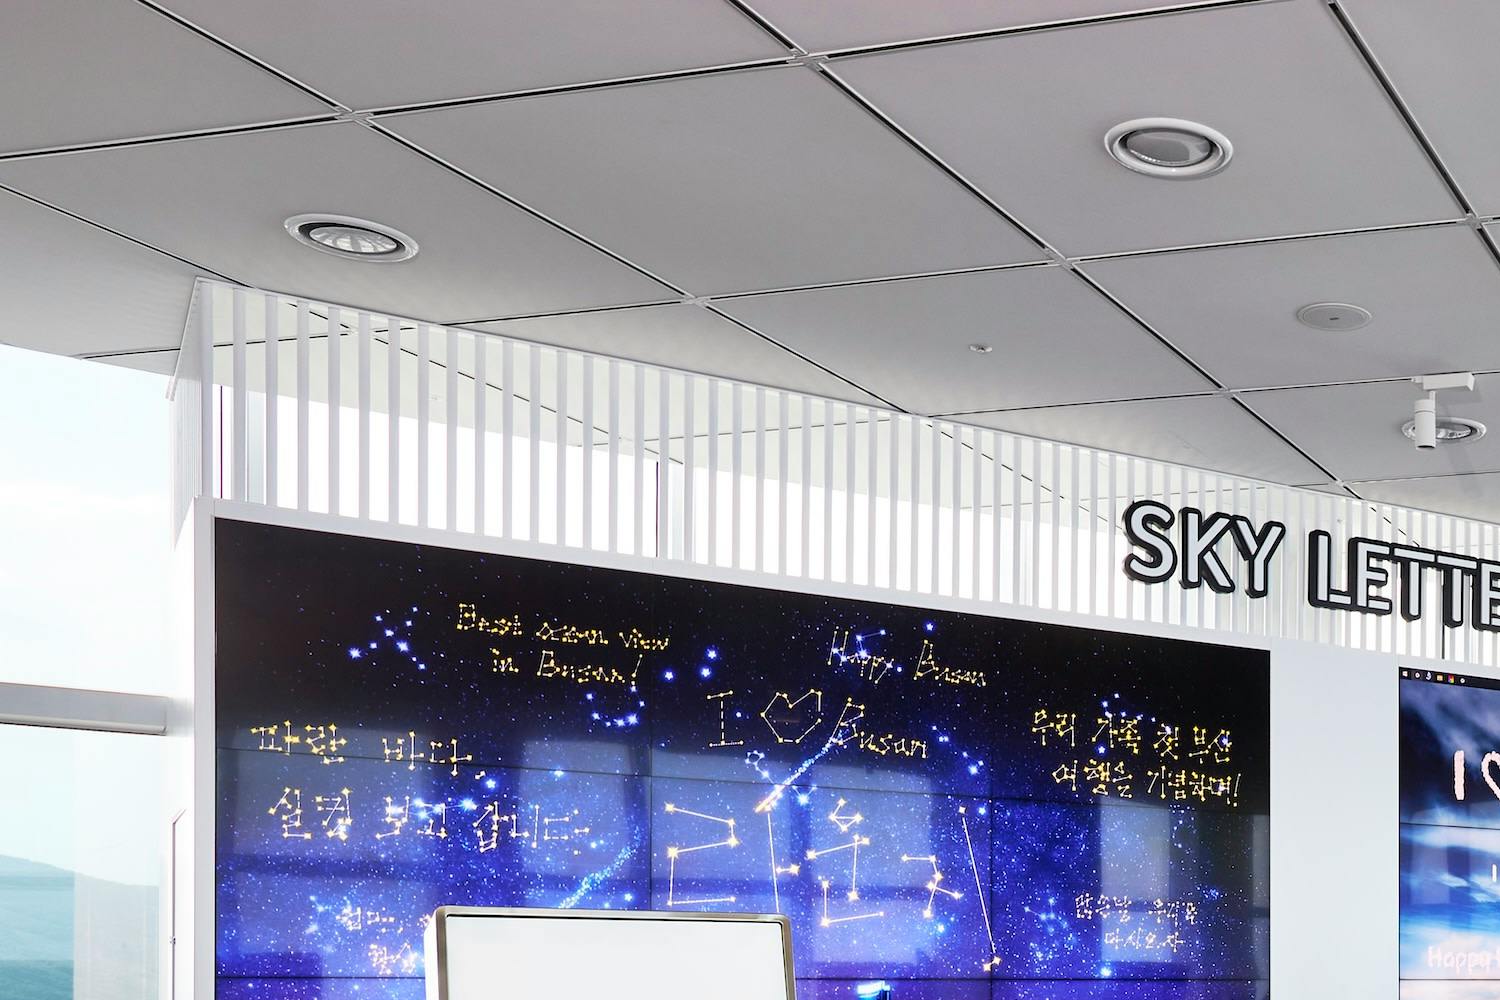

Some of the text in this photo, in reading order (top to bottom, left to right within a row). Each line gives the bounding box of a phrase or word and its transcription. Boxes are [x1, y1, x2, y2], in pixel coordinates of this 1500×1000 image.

[1122, 499, 1286, 599] SKY
[456, 602, 523, 637] Best
[913, 638, 987, 687] Busan
[707, 689, 928, 759] I Busan
[1030, 708, 1077, 748] 우리
[1091, 712, 1142, 755] 가족
[1188, 725, 1233, 764] 부산
[1051, 758, 1134, 799] 여행을
[1453, 749, 1466, 801] I
[1491, 863, 1497, 882] I
[1427, 944, 1491, 976] Happy
